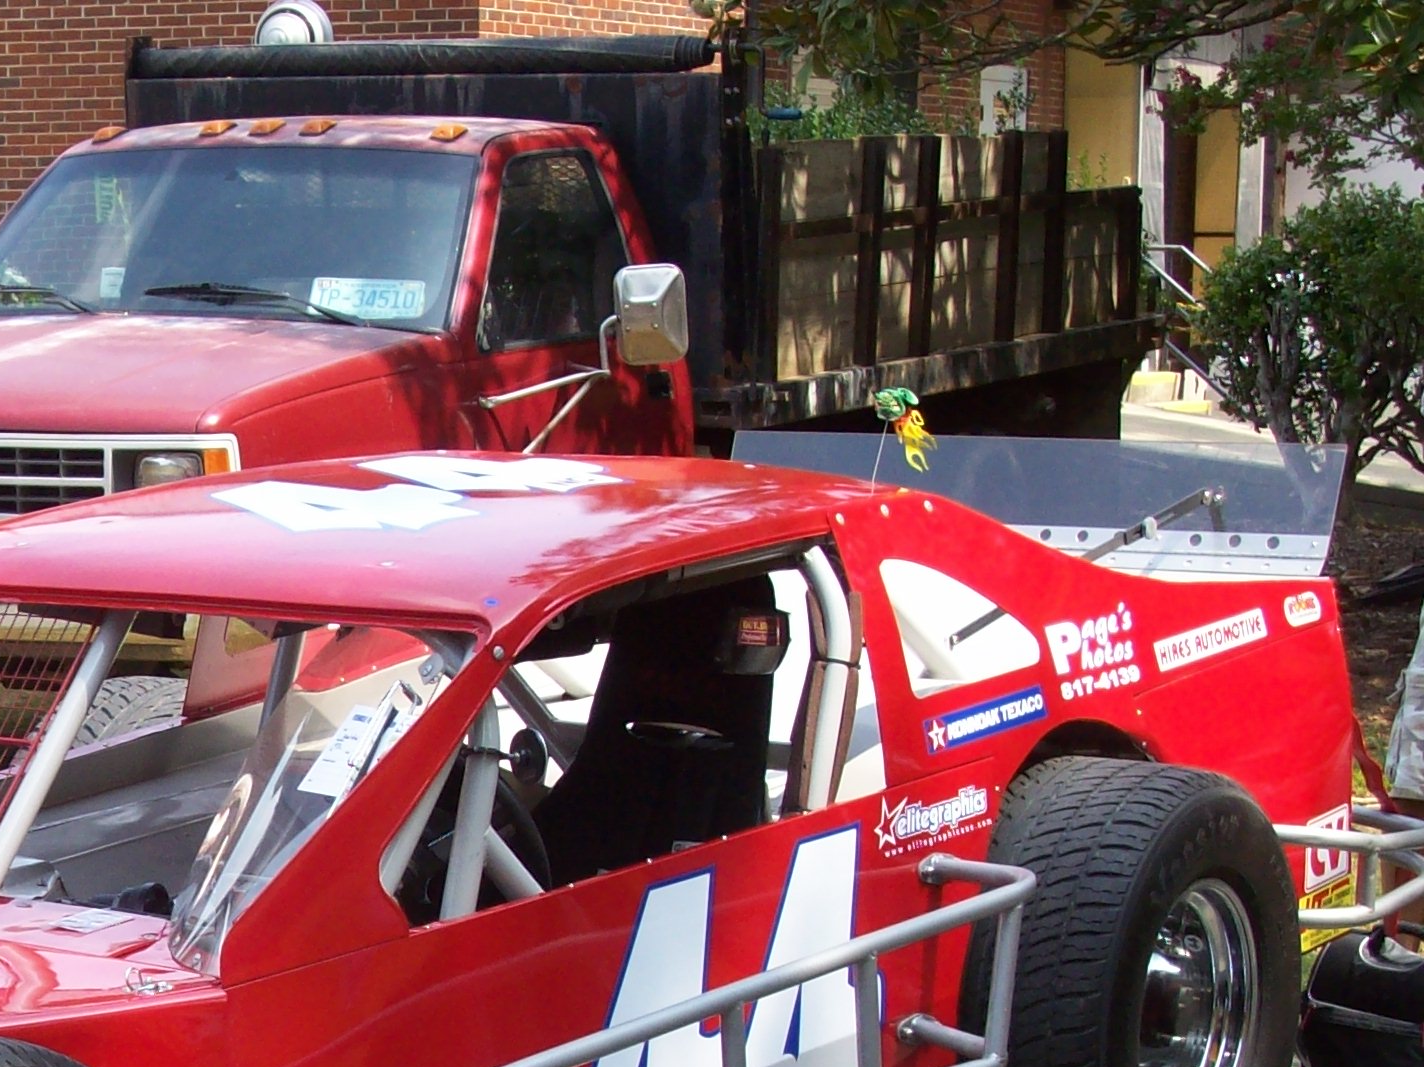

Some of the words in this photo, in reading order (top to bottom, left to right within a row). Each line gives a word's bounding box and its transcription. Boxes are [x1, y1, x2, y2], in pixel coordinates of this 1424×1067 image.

[1195, 616, 1262, 652] AUTOMOTIVE
[1060, 664, 1141, 700] 817-4139
[999, 693, 1043, 721] TEXACO
